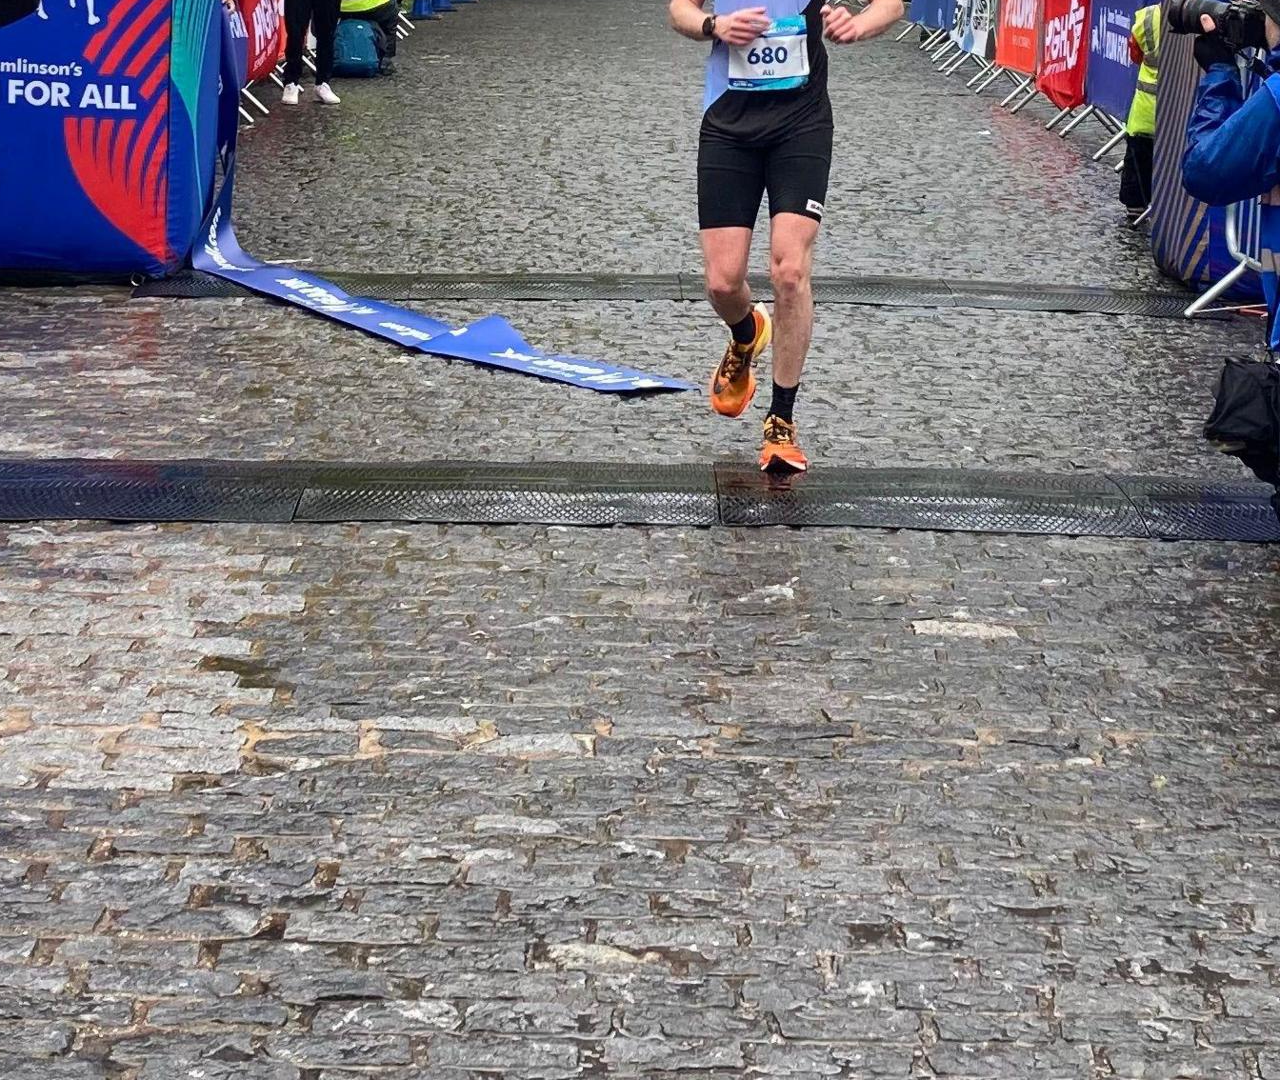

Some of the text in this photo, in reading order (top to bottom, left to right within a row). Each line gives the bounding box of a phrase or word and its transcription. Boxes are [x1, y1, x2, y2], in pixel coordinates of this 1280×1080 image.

[747, 46, 788, 65] 680
[8, 79, 71, 108] FOR
[79, 83, 137, 110] ALL
